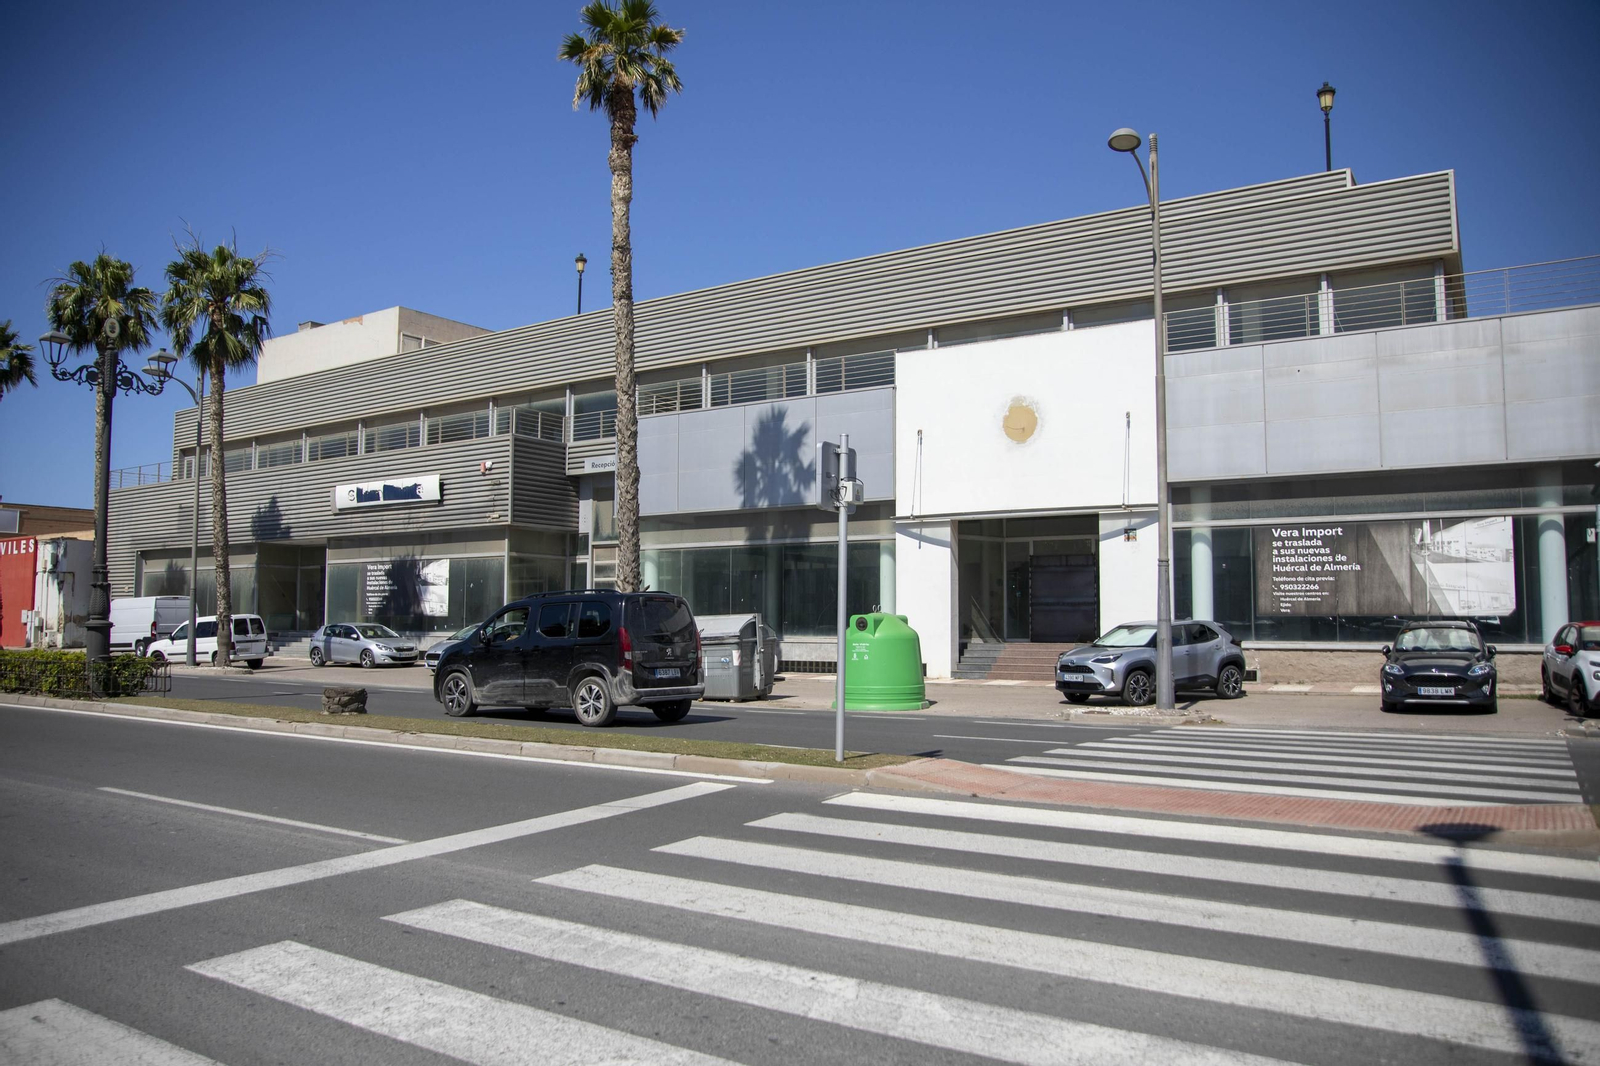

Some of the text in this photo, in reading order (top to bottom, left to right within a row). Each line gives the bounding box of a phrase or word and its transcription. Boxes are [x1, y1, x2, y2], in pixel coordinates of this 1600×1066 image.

[1272, 527, 1343, 538] Vera Import
[0, 539, 35, 555] VILES
[1284, 538, 1323, 547] traslada
[1272, 553, 1348, 563] instalaciones de
[1272, 562, 1361, 572] Huércal de Almería
